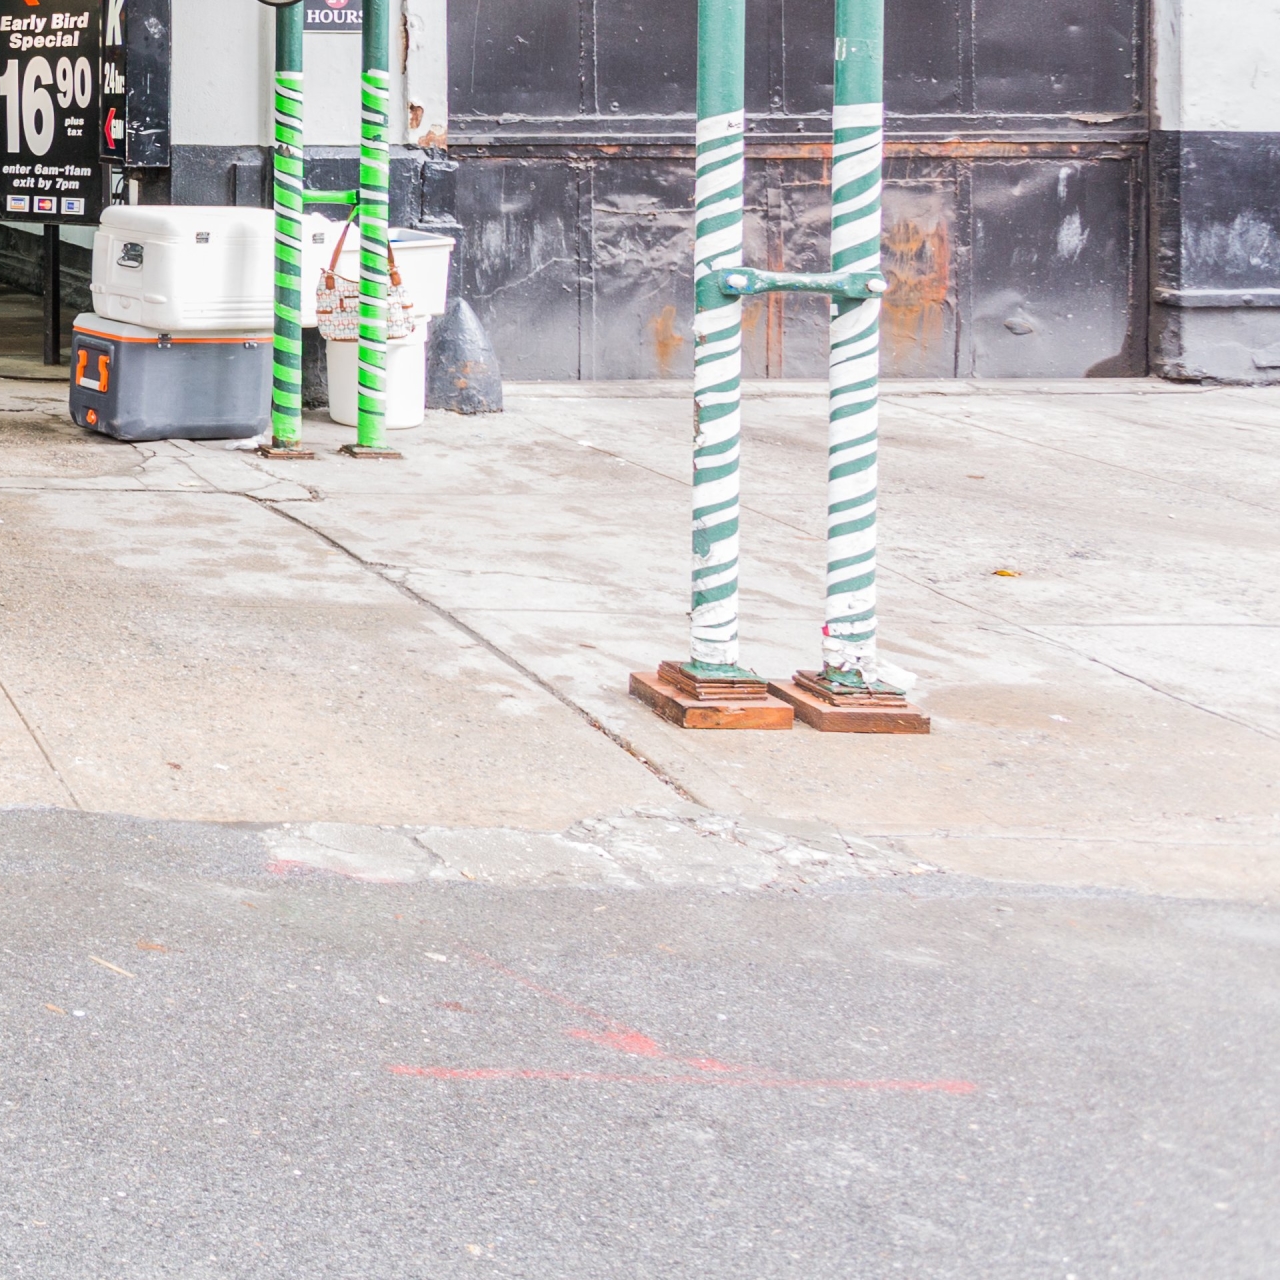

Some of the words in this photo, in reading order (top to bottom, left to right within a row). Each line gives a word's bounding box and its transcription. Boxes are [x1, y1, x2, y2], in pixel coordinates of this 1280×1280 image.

[0, 13, 47, 33] Early
[51, 12, 90, 29] Bird
[9, 31, 80, 51] Special
[56, 56, 92, 109] 90
[64, 116, 84, 128] plus
[67, 127, 83, 137] tax
[2, 164, 32, 174] enter
[34, 164, 92, 176] 6am-11am
[13, 178, 35, 188] exit
[38, 178, 52, 191] by
[55, 178, 80, 191] 7pm
